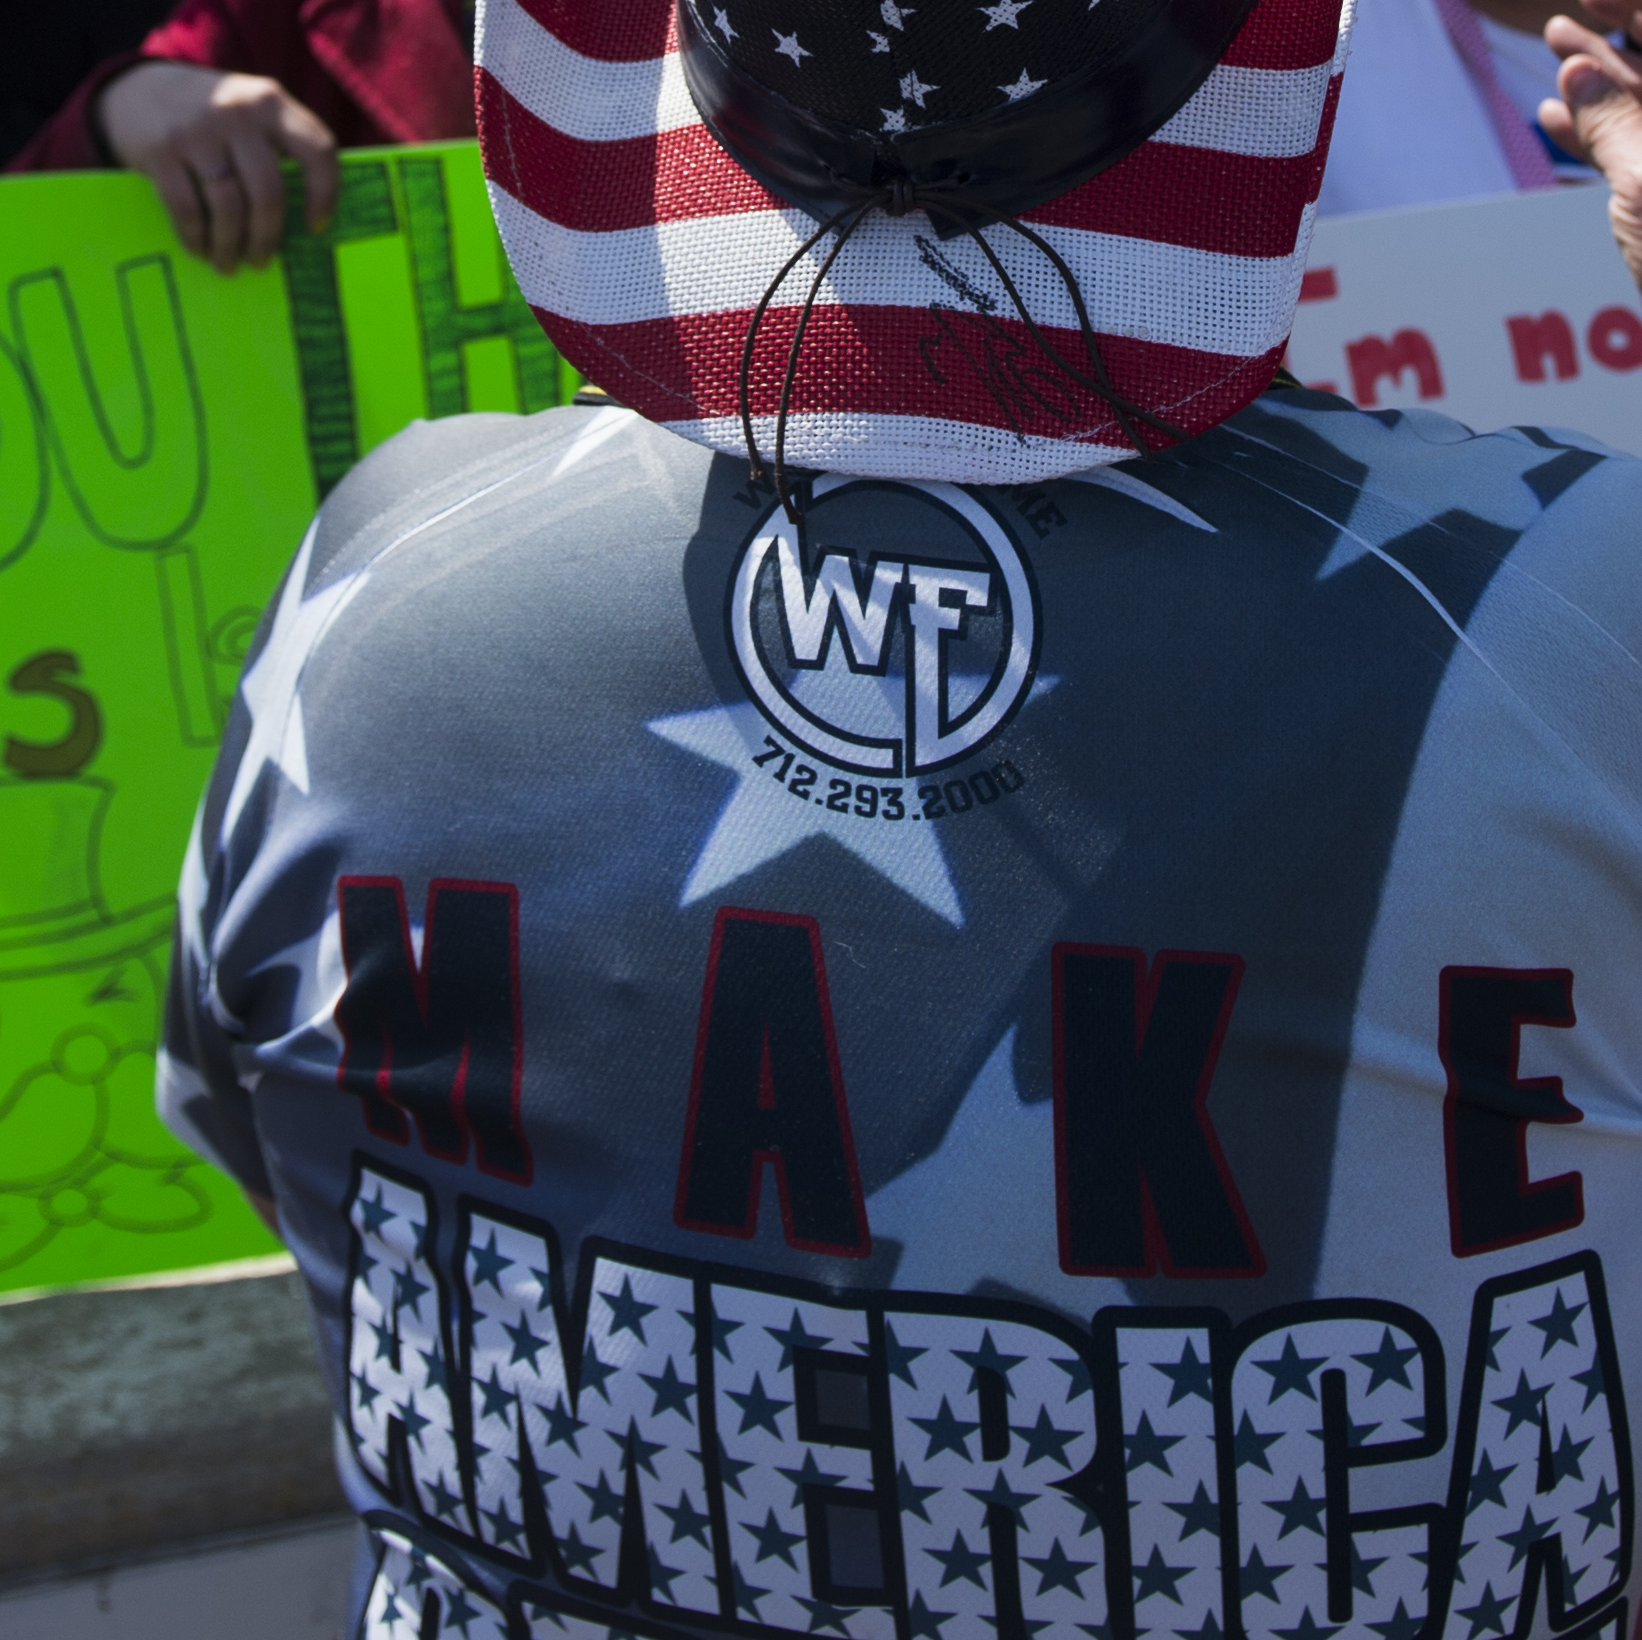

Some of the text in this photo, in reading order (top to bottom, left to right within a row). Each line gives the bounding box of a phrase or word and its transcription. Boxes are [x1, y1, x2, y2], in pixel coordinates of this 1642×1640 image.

[750, 733, 1027, 824] 712.293.2000
[333, 872, 1587, 1280] MAKE
[341, 1146, 1636, 1640] AMERICA
